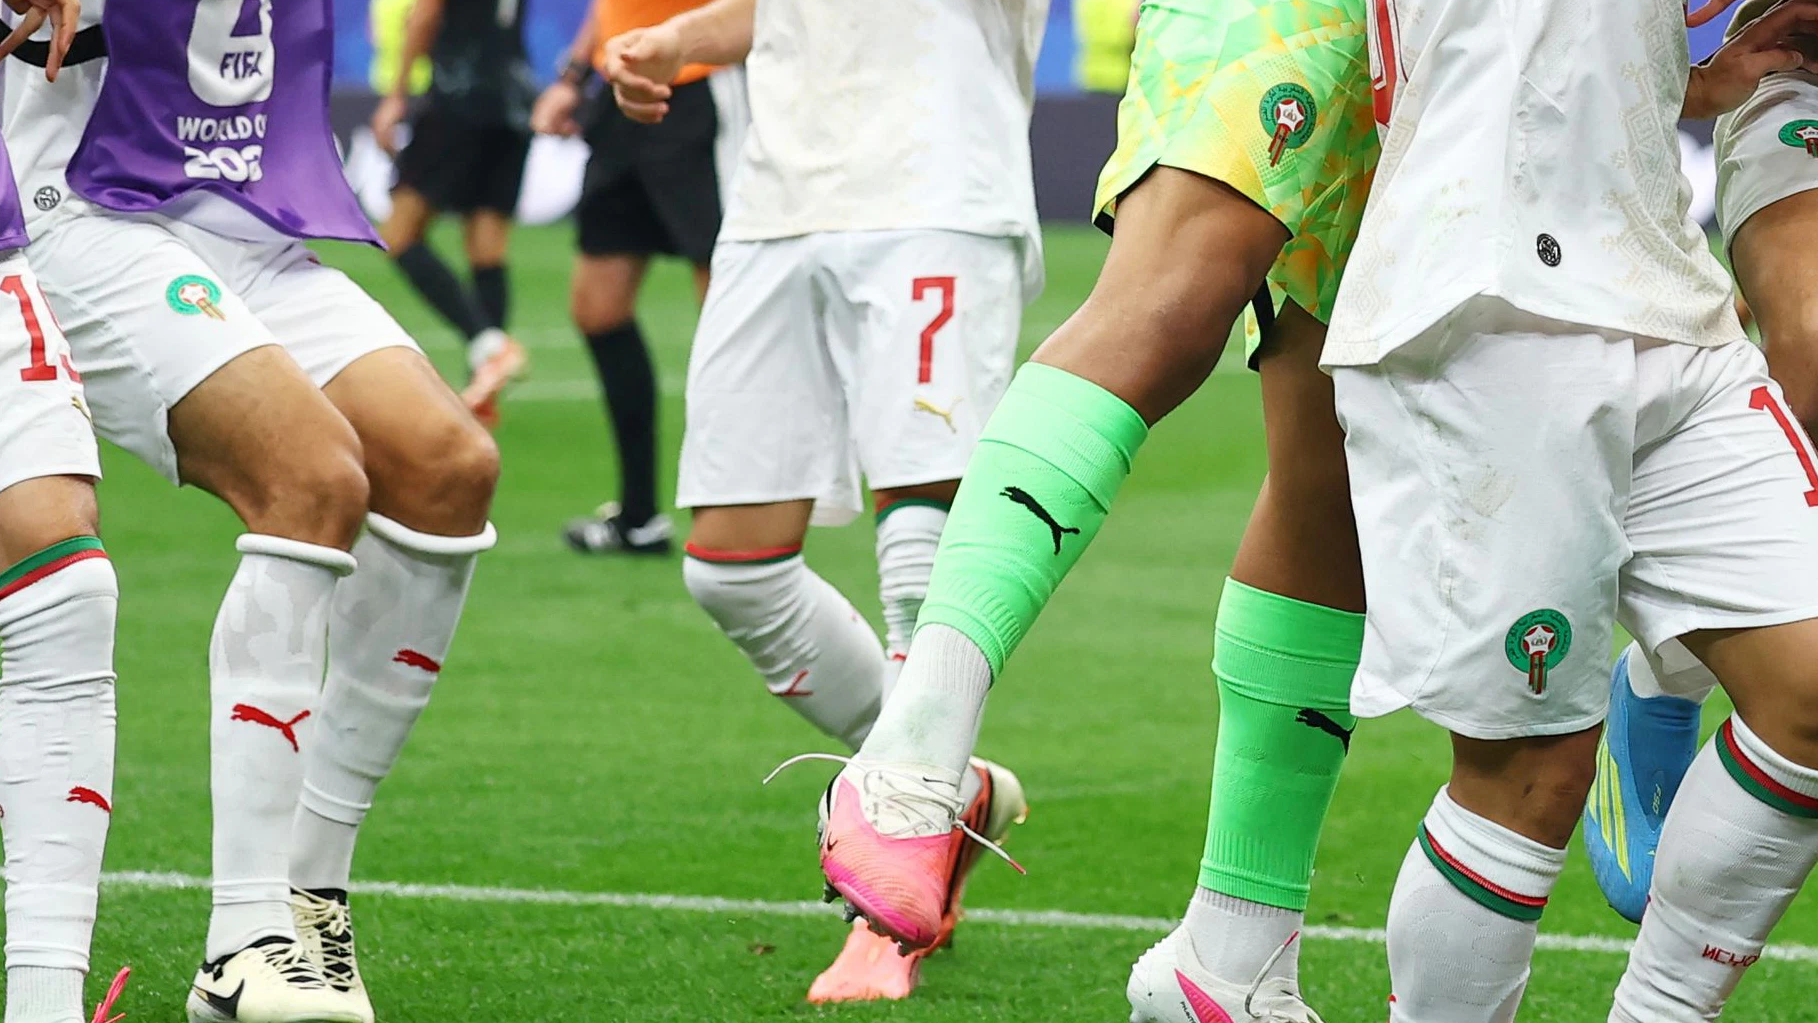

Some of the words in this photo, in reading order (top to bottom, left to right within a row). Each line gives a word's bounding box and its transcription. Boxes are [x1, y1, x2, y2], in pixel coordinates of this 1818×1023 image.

[183, 143, 263, 183] 202
[0, 274, 82, 383] 1
[912, 276, 957, 384] 7
